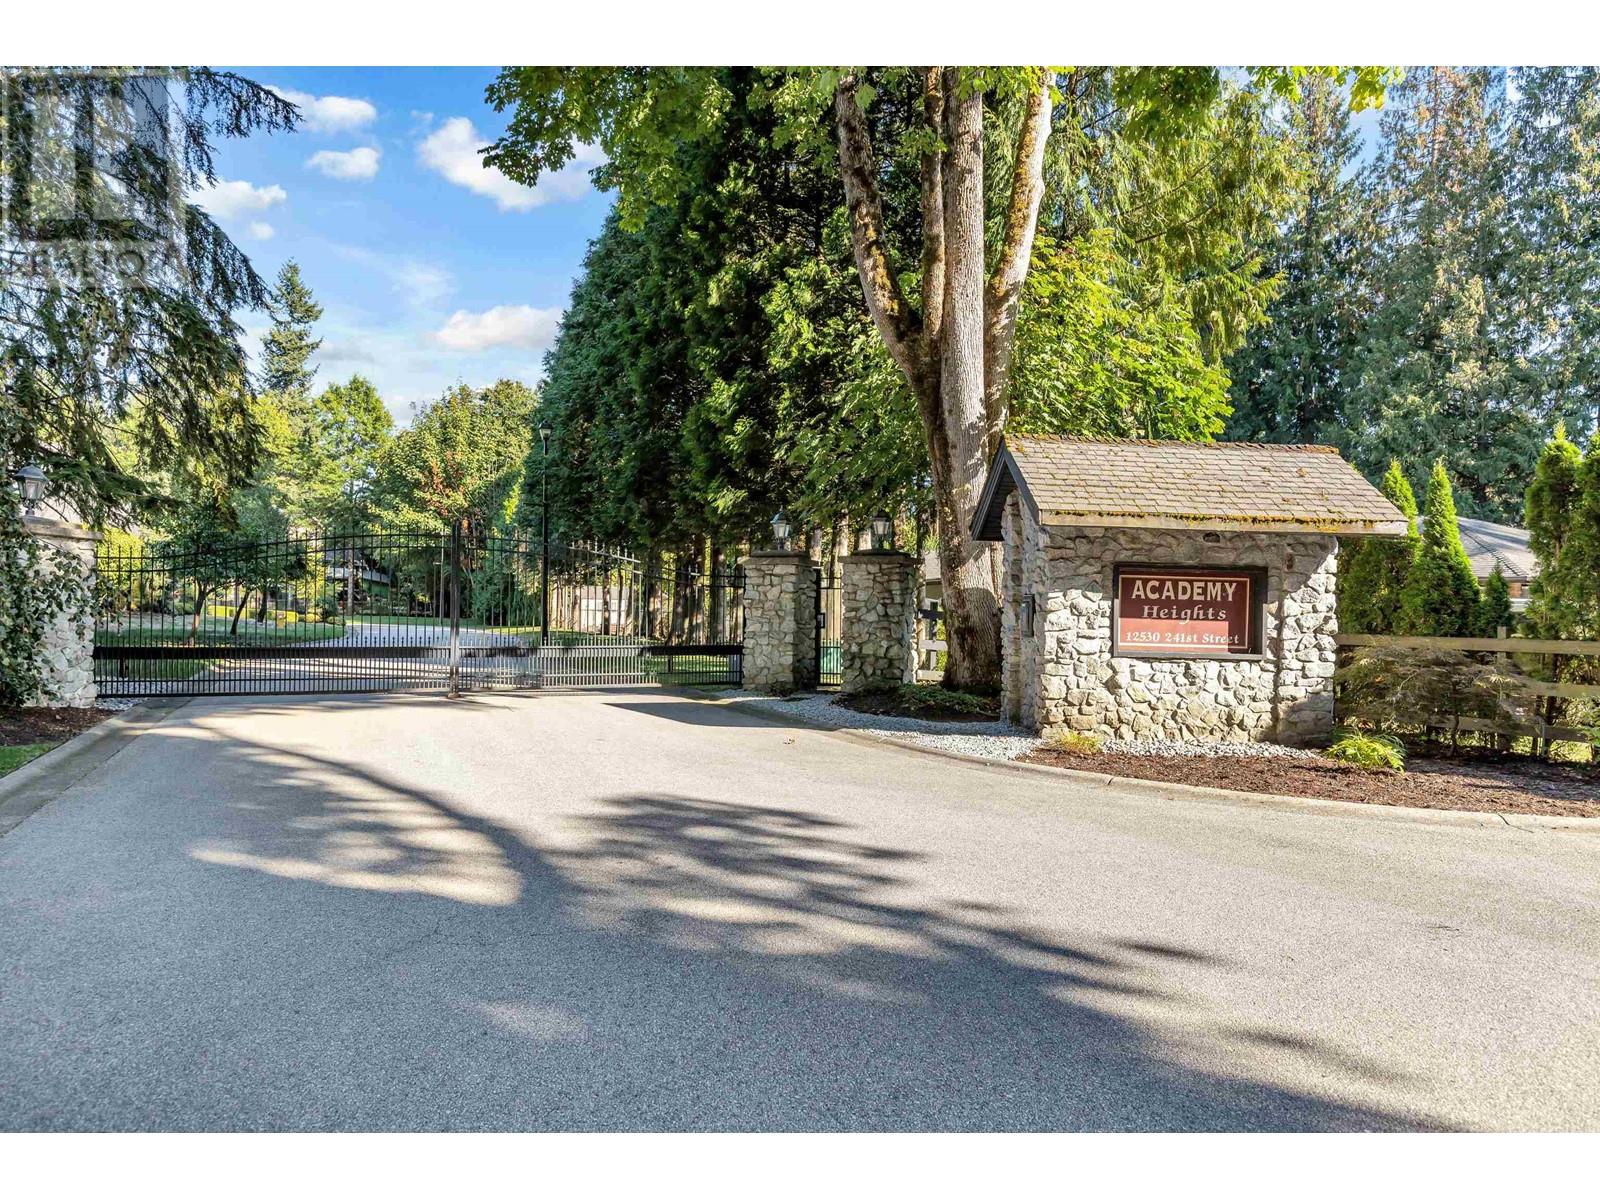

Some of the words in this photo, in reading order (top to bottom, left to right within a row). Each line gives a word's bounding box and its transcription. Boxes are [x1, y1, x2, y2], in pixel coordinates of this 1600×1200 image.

[1131, 580, 1237, 601] ACADEMY
[1142, 604, 1227, 624] Heights
[1126, 631, 1160, 642] 12530
[1165, 632, 1198, 643] 241st
[1202, 633, 1239, 644] Street
